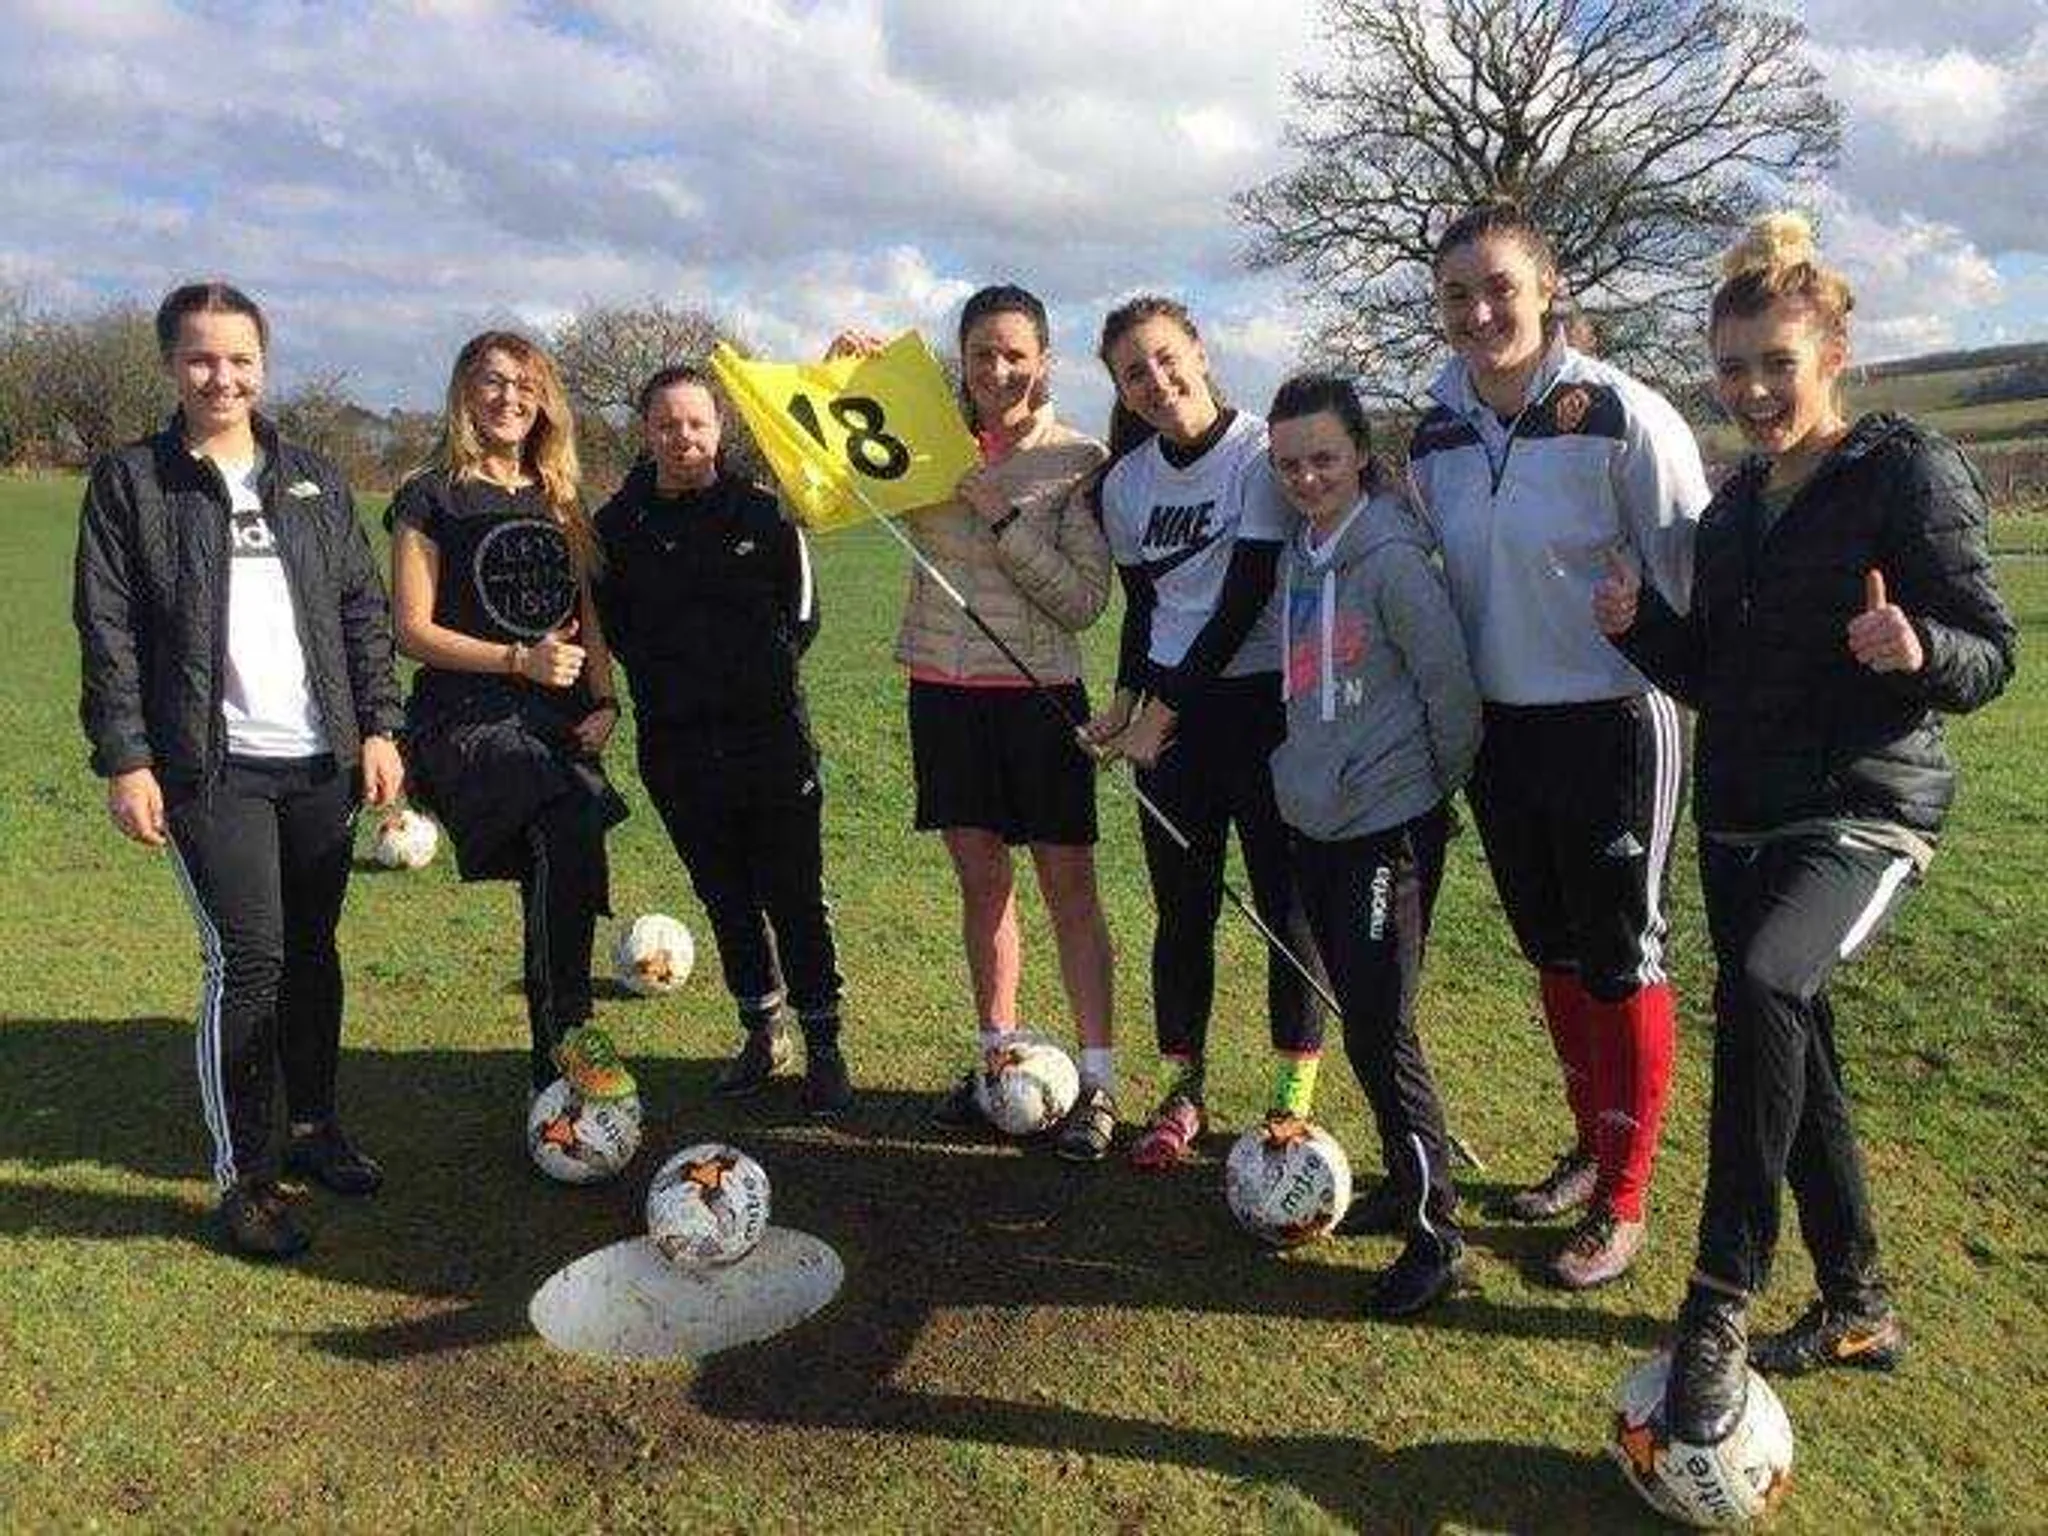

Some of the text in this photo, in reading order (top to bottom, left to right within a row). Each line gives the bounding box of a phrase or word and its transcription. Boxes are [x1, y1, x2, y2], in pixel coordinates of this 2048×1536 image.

[787, 393, 911, 480] 18
[1142, 500, 1215, 547] NIKE
[1281, 1154, 1321, 1216] mitre
